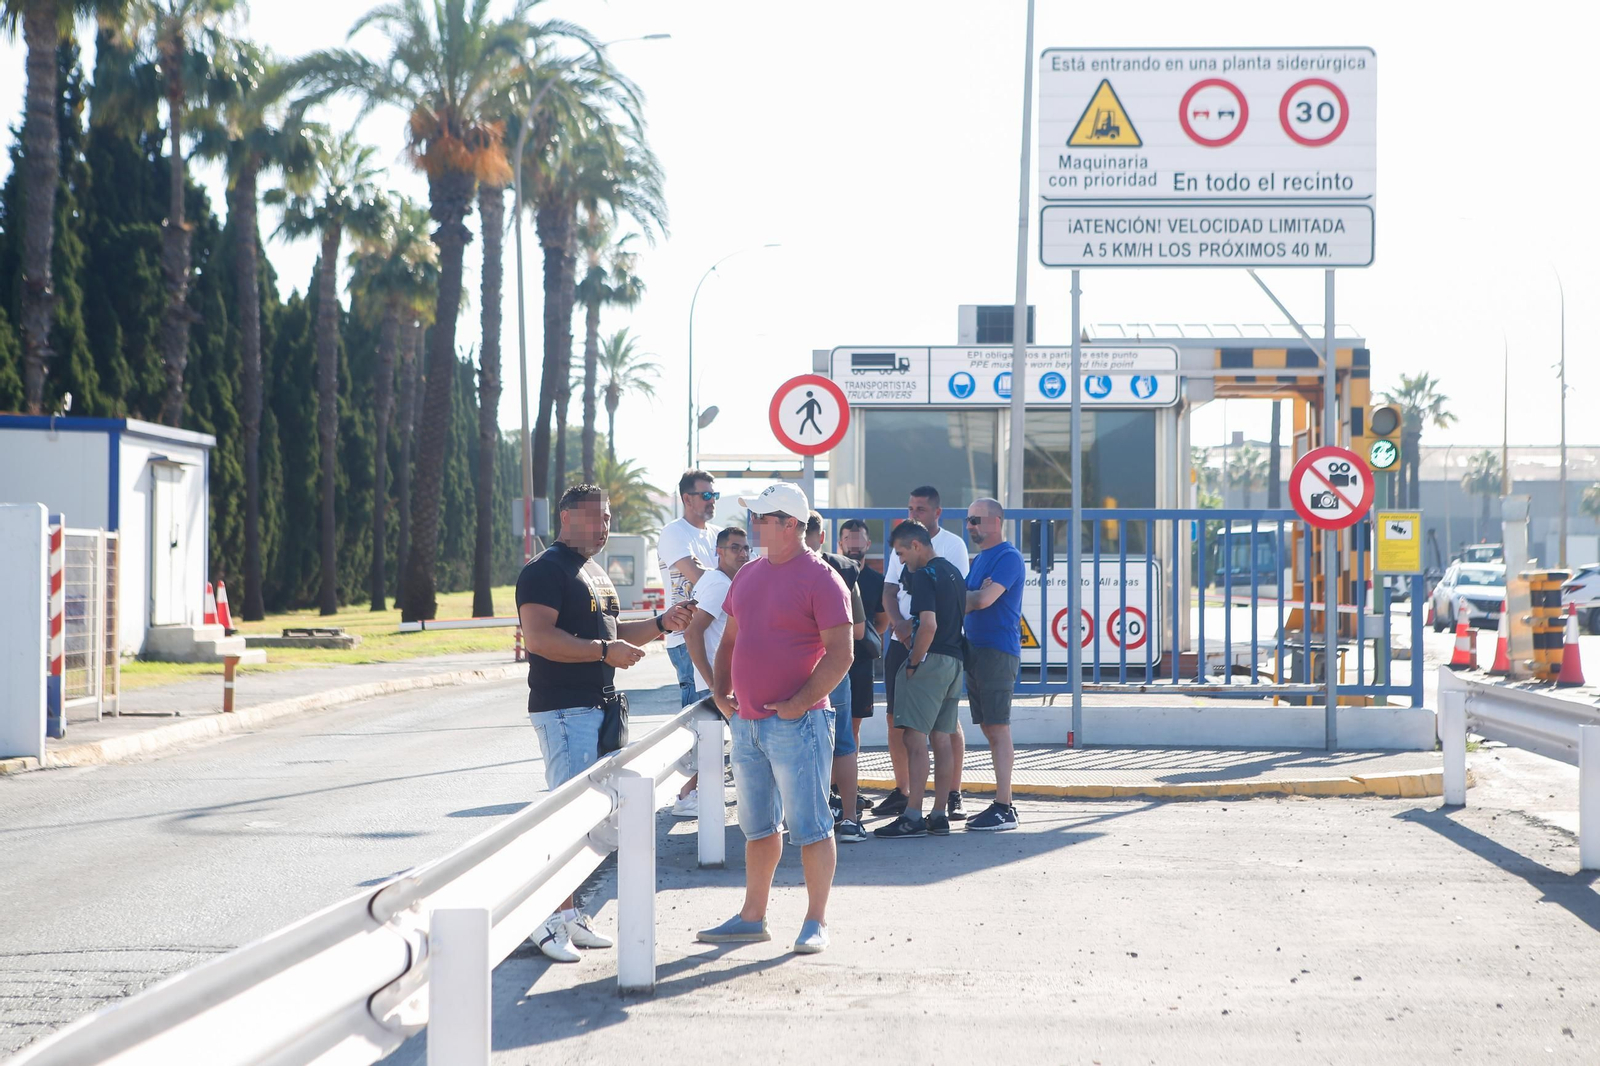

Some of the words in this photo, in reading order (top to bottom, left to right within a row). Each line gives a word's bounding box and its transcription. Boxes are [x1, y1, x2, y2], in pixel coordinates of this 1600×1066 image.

[1052, 55, 1085, 71] Está
[1091, 56, 1160, 71] entrando
[1166, 59, 1183, 71] en
[1190, 59, 1217, 71] una
[1223, 55, 1271, 74] planta
[1277, 54, 1366, 73] siderúrgica
[1296, 102, 1335, 123] 30
[1059, 154, 1148, 172] Maquinaria
[1049, 175, 1077, 187] con
[1084, 172, 1157, 189] prioridad
[1173, 173, 1198, 191] En
[1206, 172, 1250, 191] todo
[1258, 172, 1275, 191] el
[1283, 171, 1353, 191] recinto
[1068, 216, 1161, 234] ¡ATENCIÓN!
[1168, 218, 1263, 234] VELOCIDAD
[1269, 218, 1345, 234] LIMITADA
[1083, 242, 1094, 257] A
[1099, 242, 1107, 257] 5
[1113, 242, 1153, 257] KM/H
[1159, 242, 1191, 257] LOS
[1199, 239, 1286, 257] PRÓXIMOS
[1291, 242, 1310, 257] 40
[1315, 242, 1332, 257] M.
[967, 351, 982, 359] EPI
[1112, 352, 1138, 360] punto
[1110, 361, 1134, 370] point
[845, 381, 917, 390] TRANSPORTISTAS
[847, 391, 875, 399] TRUCK
[876, 391, 912, 399] DRIVERS
[1099, 577, 1110, 586] All
